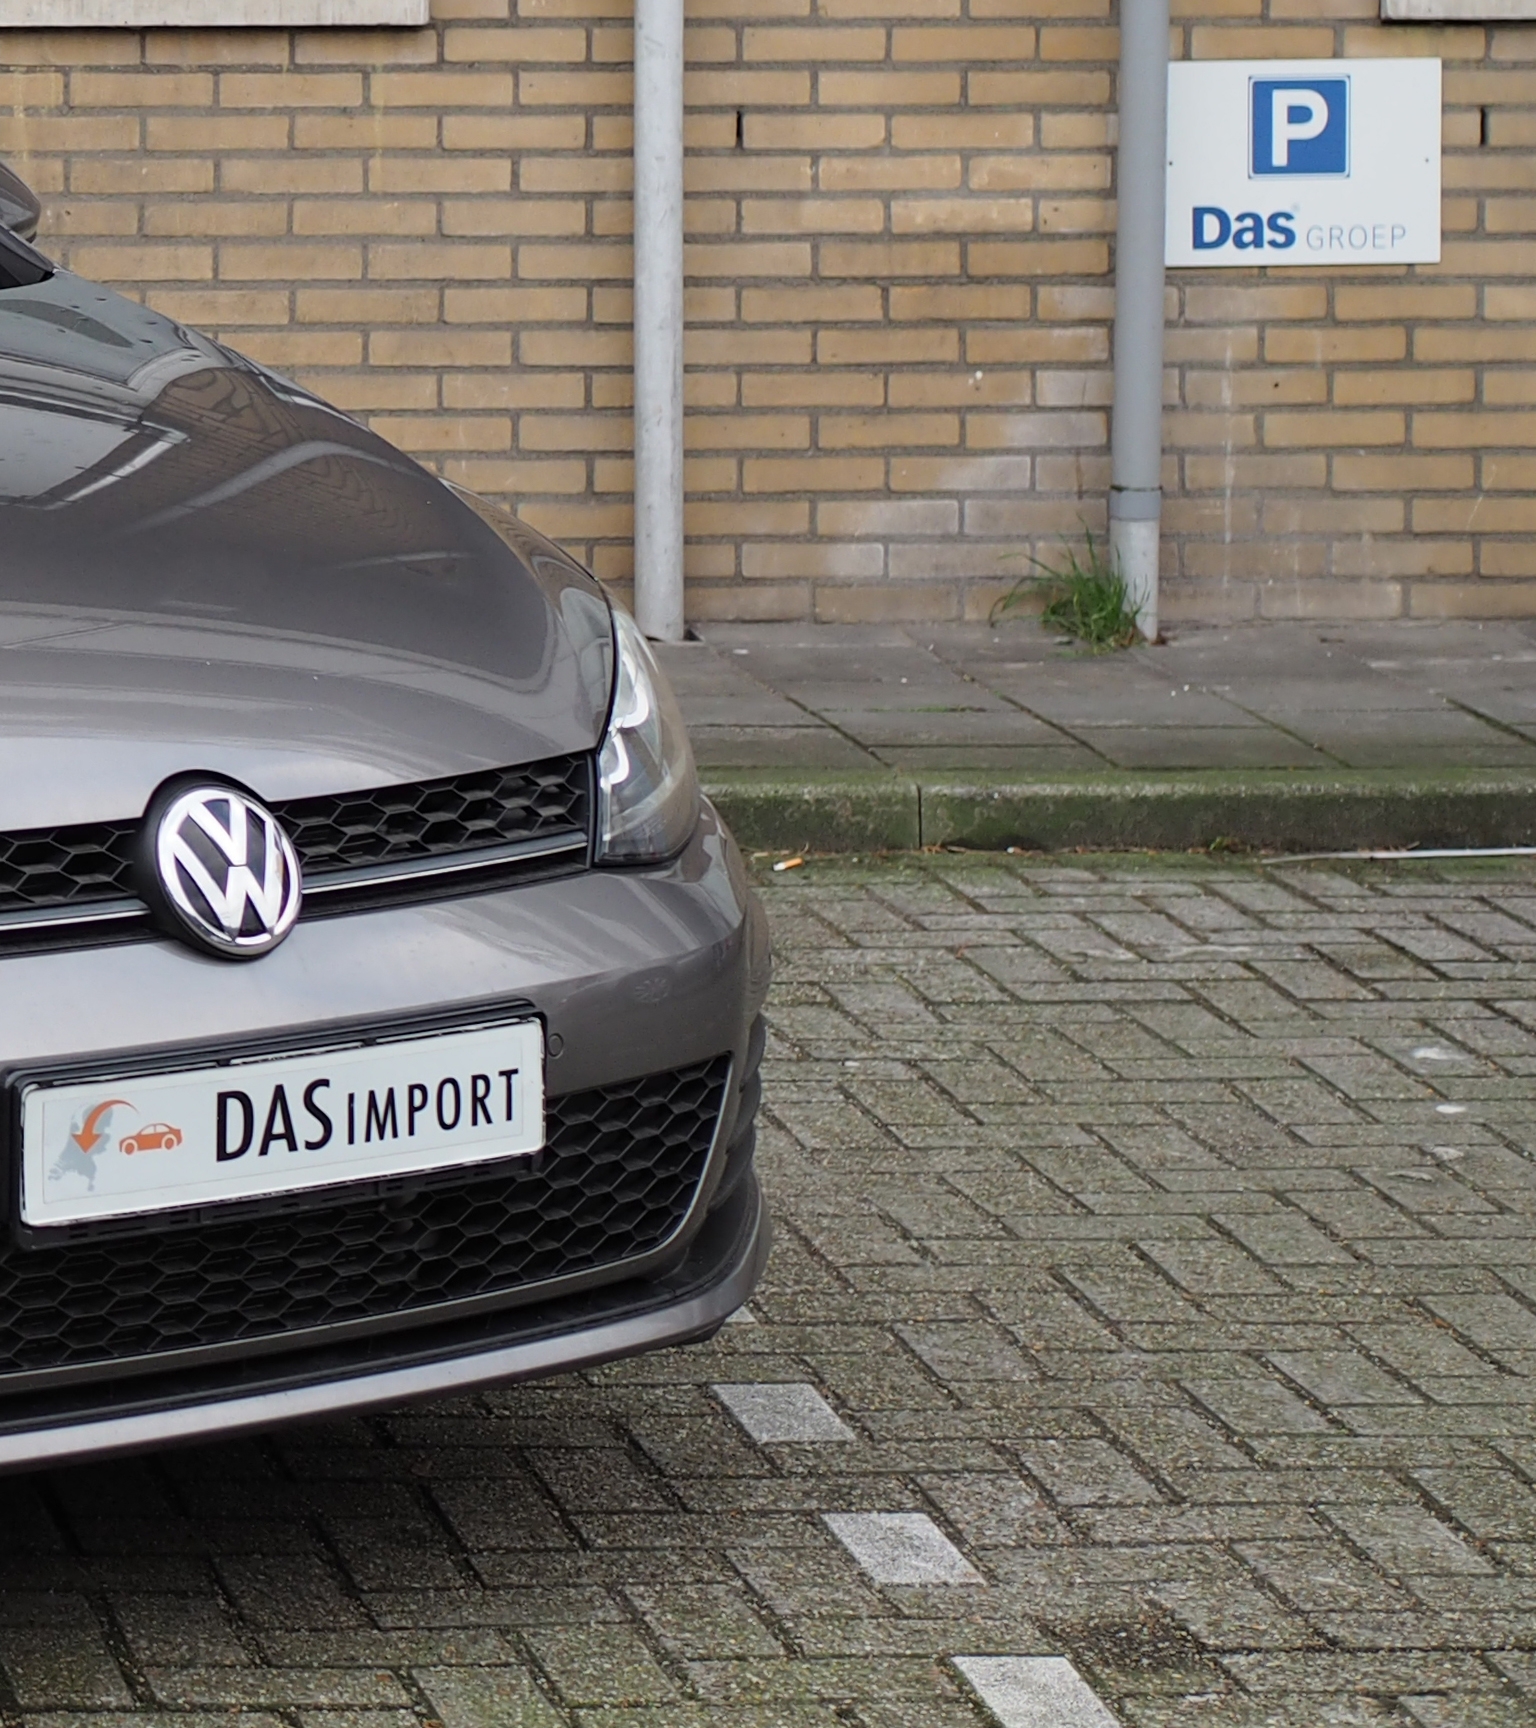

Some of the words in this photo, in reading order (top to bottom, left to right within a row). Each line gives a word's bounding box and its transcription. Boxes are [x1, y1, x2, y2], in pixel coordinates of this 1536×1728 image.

[1271, 88, 1329, 167] P
[1192, 206, 1297, 251] Das
[1306, 224, 1407, 251] GROEP
